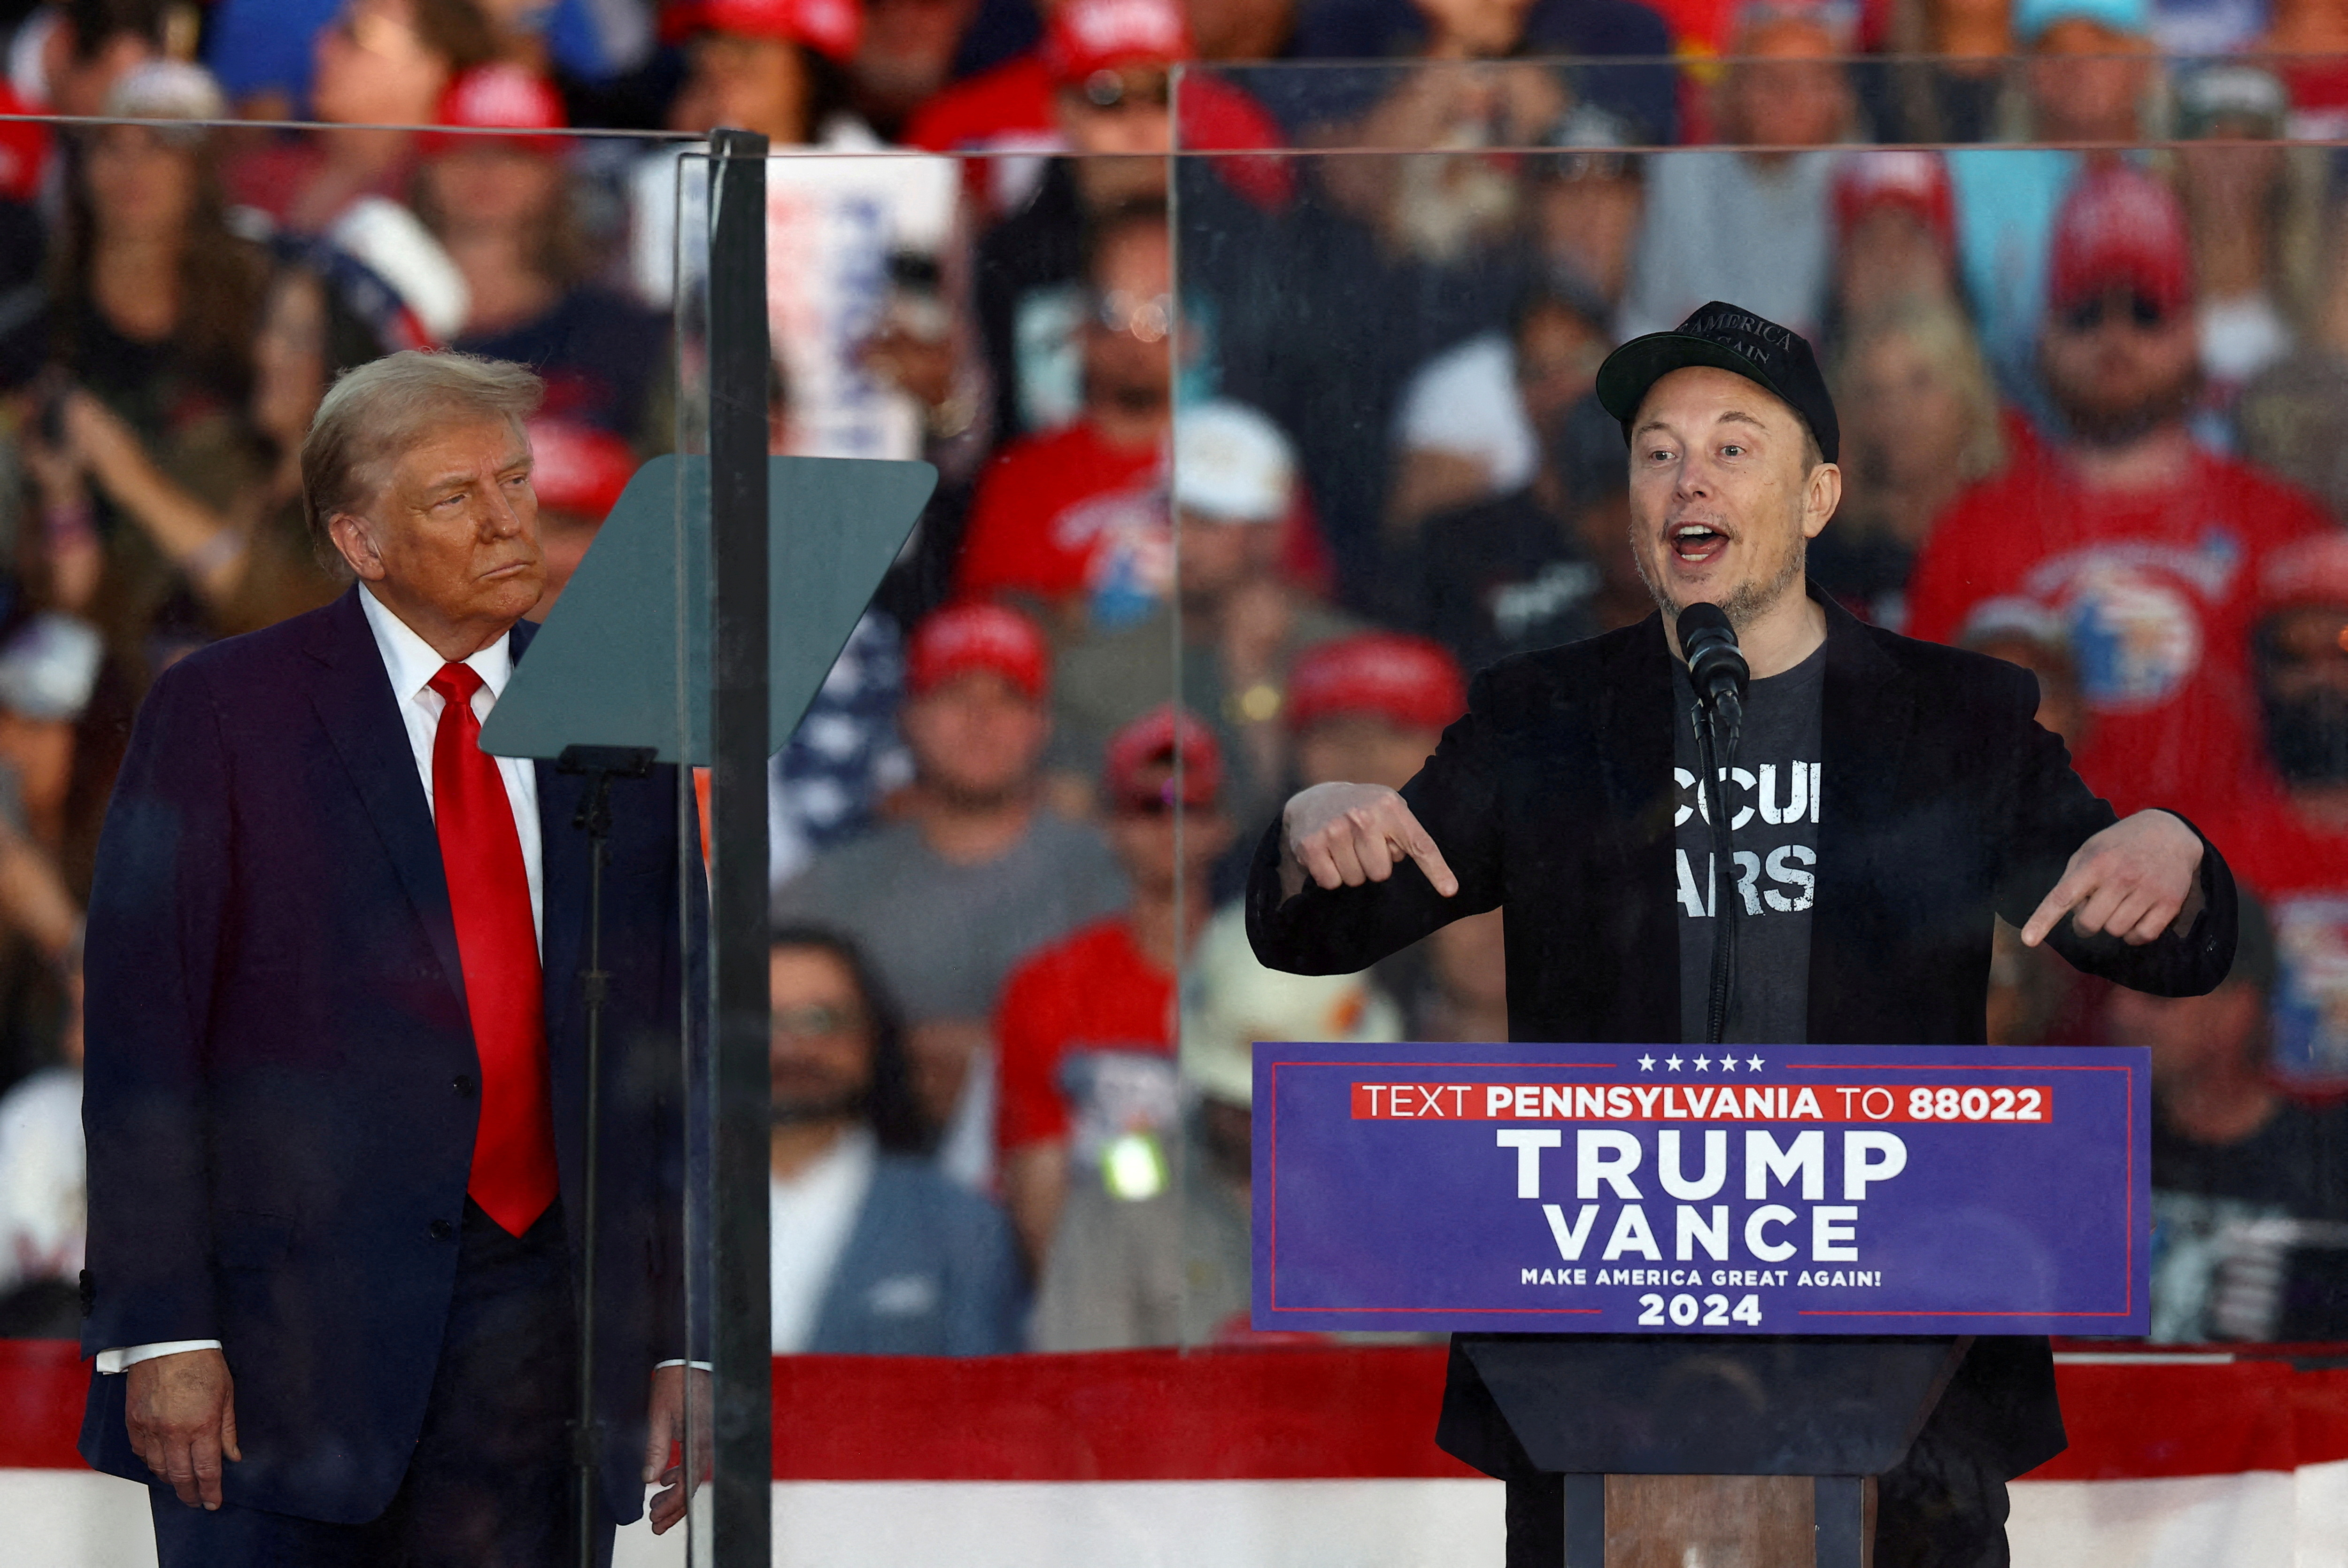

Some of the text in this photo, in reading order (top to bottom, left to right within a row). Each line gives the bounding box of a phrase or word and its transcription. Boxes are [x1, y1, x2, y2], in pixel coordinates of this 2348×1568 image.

[1689, 313, 1791, 353] AMERICA
[1707, 334, 1770, 364] AIN
[1362, 1085, 2041, 1120] TEXT PENNSYLVANIA TO 88022
[1497, 1129, 1907, 1201] TRUMP
[1542, 1204, 1858, 1262] VANCE
[1522, 1268, 1881, 1287] MAKE AMERICA GREAT AGAIN!
[1638, 1293, 1762, 1326] 2024
